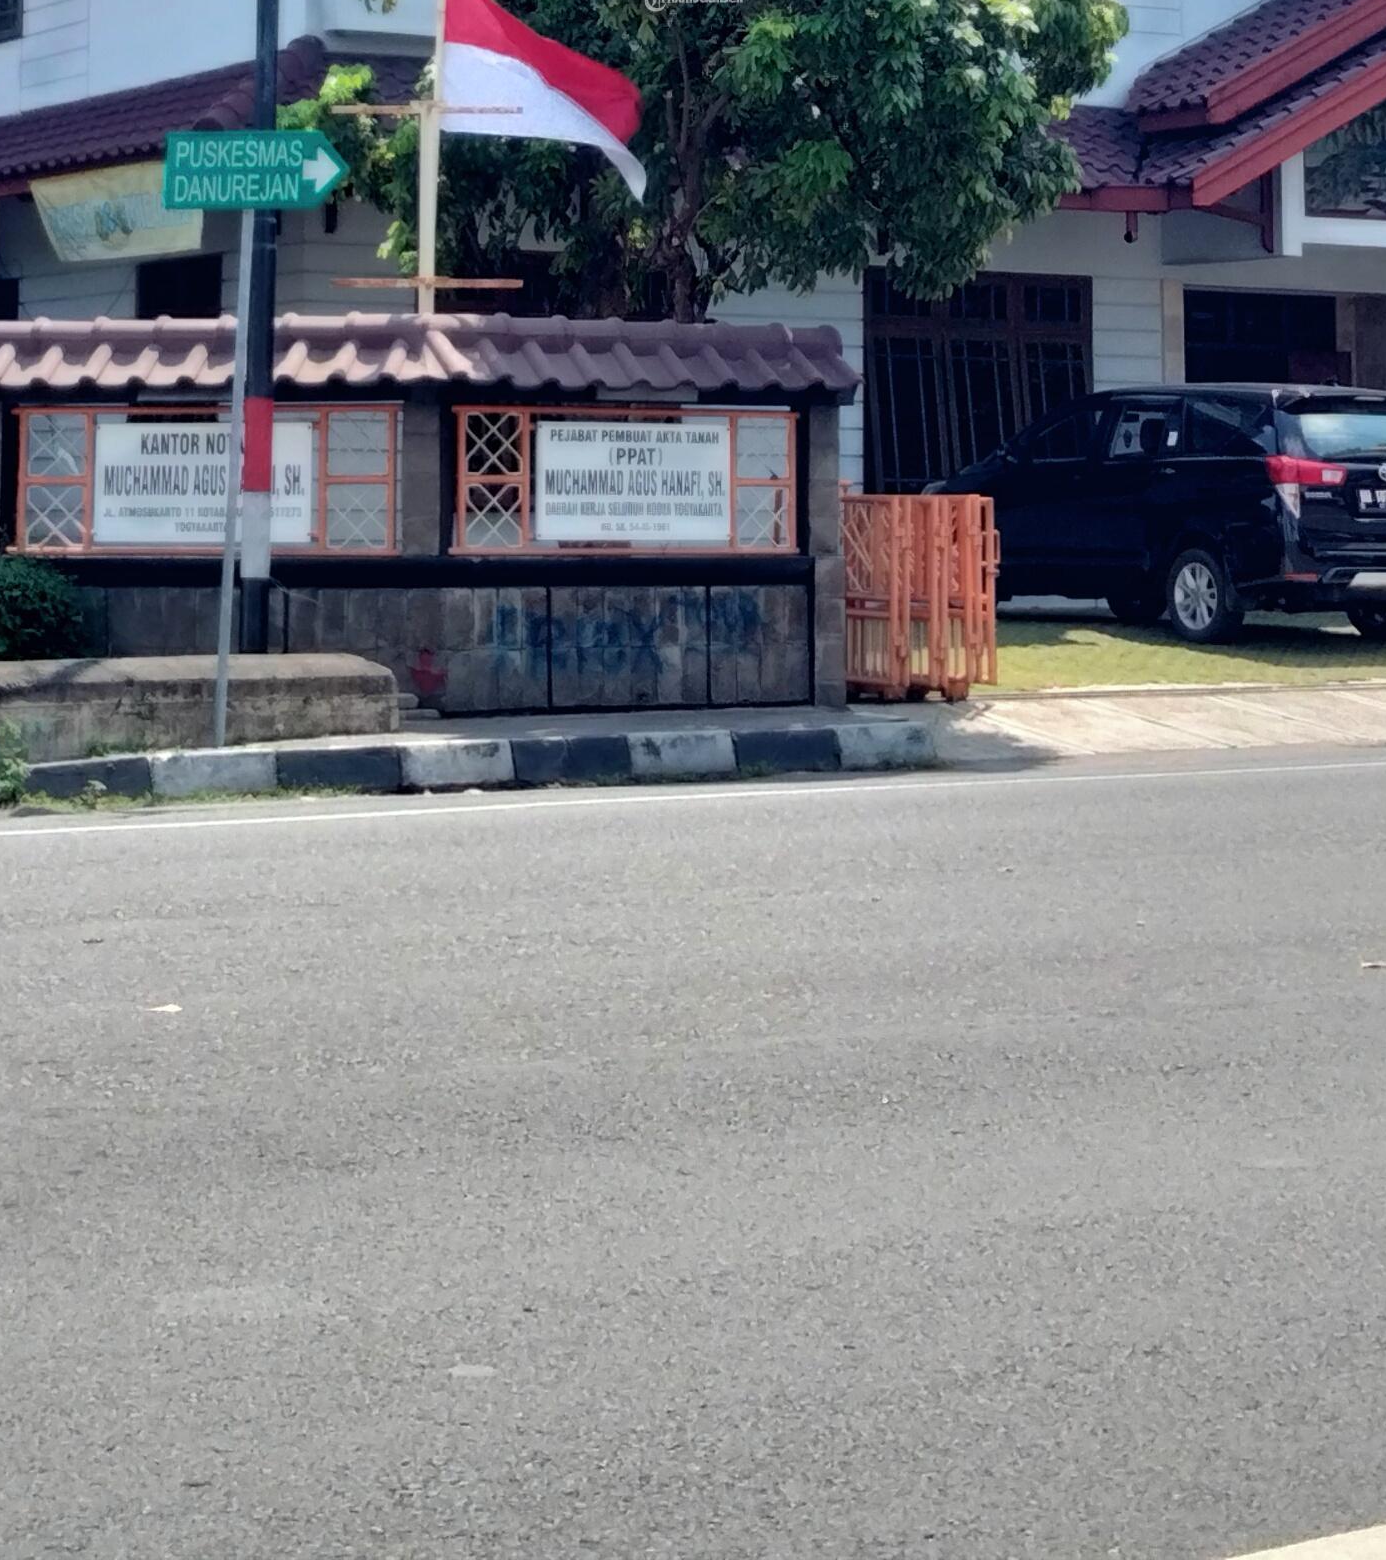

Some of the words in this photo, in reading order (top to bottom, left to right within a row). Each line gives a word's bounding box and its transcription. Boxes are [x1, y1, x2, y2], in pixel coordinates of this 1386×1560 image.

[175, 139, 304, 169] PUSKESMAS
[174, 174, 300, 202] DANUREJAN
[141, 433, 200, 456] KANTOR
[550, 429, 598, 443] PEJABAT
[601, 430, 652, 444] PEMBUAT
[656, 431, 682, 444] AKTA
[686, 431, 720, 444] TANAH
[608, 447, 663, 467] (PPAT)
[103, 464, 189, 497] MUCHAMMAD
[192, 464, 227, 496] AGUS
[284, 464, 306, 496] SH.
[545, 469, 624, 496] MUCHAMMAD
[627, 470, 658, 497] AGUS
[661, 471, 705, 500] HANAFI,
[708, 471, 726, 497] SH.
[580, 502, 606, 517] KERJA
